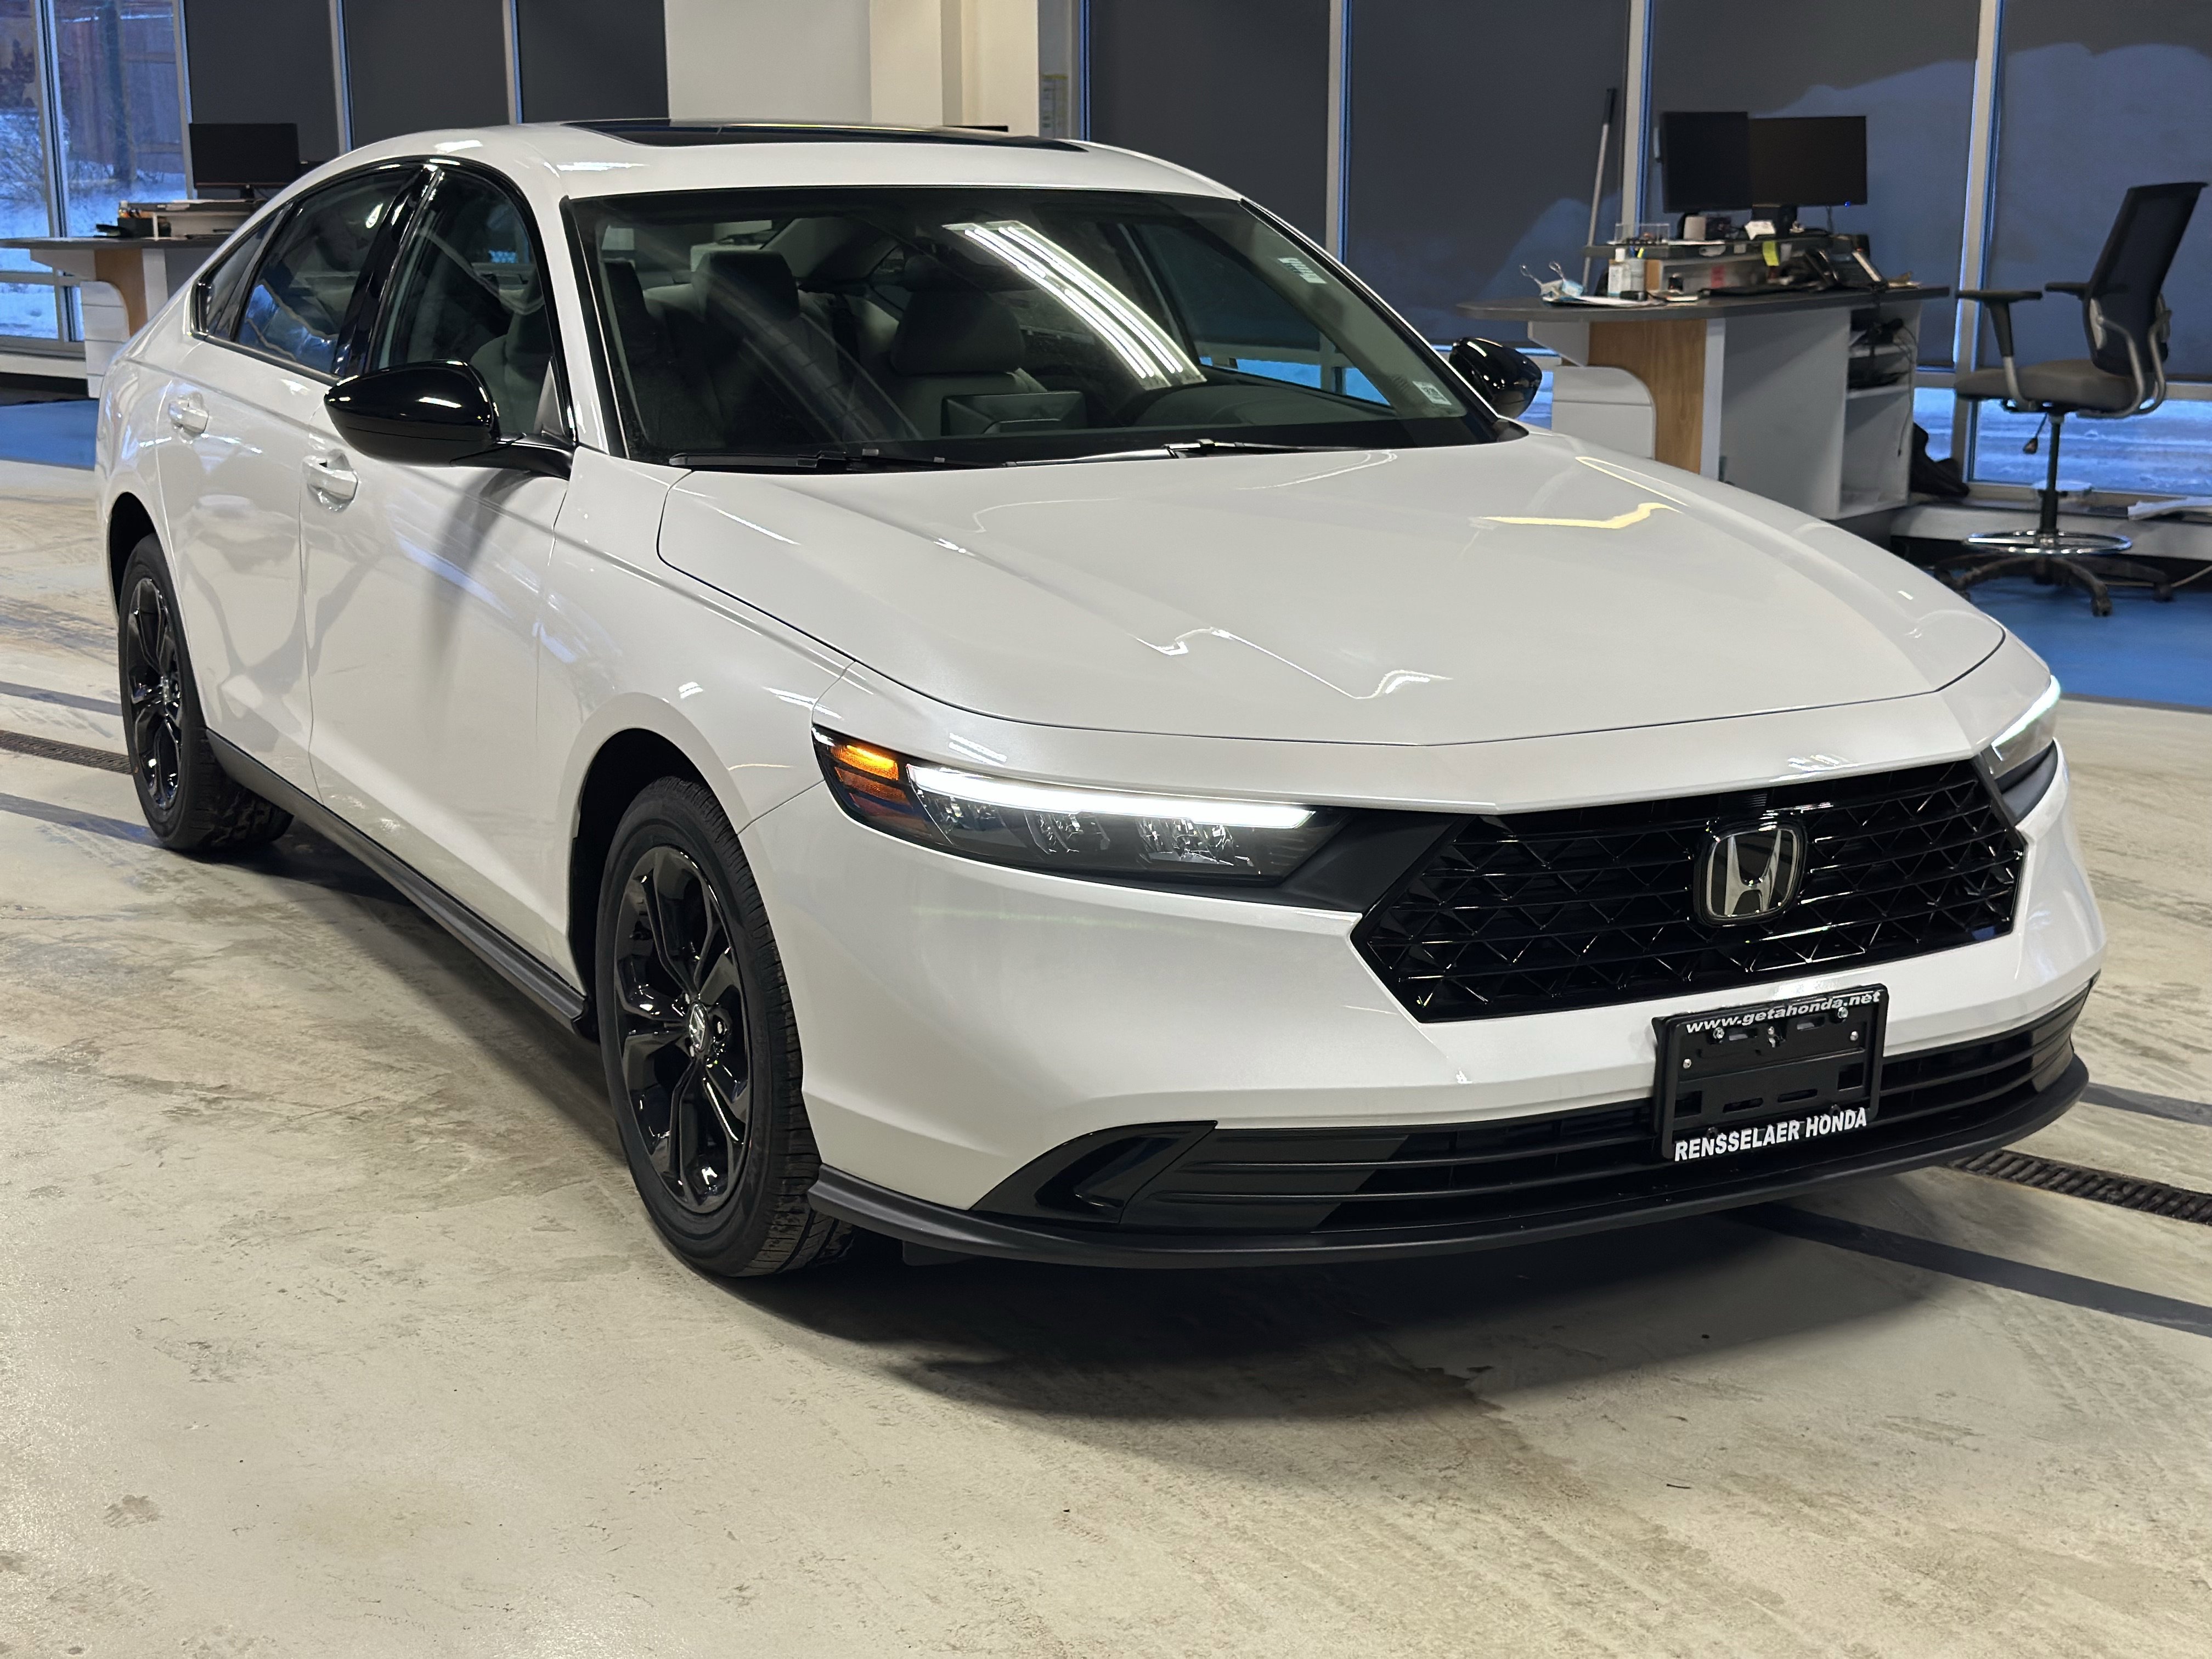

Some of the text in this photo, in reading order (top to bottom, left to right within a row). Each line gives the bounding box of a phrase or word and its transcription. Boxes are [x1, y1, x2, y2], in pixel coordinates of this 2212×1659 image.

[1686, 990, 1881, 1034] www.getahonda.net
[1674, 1107, 1867, 1161] RENSSELAER HONDA
